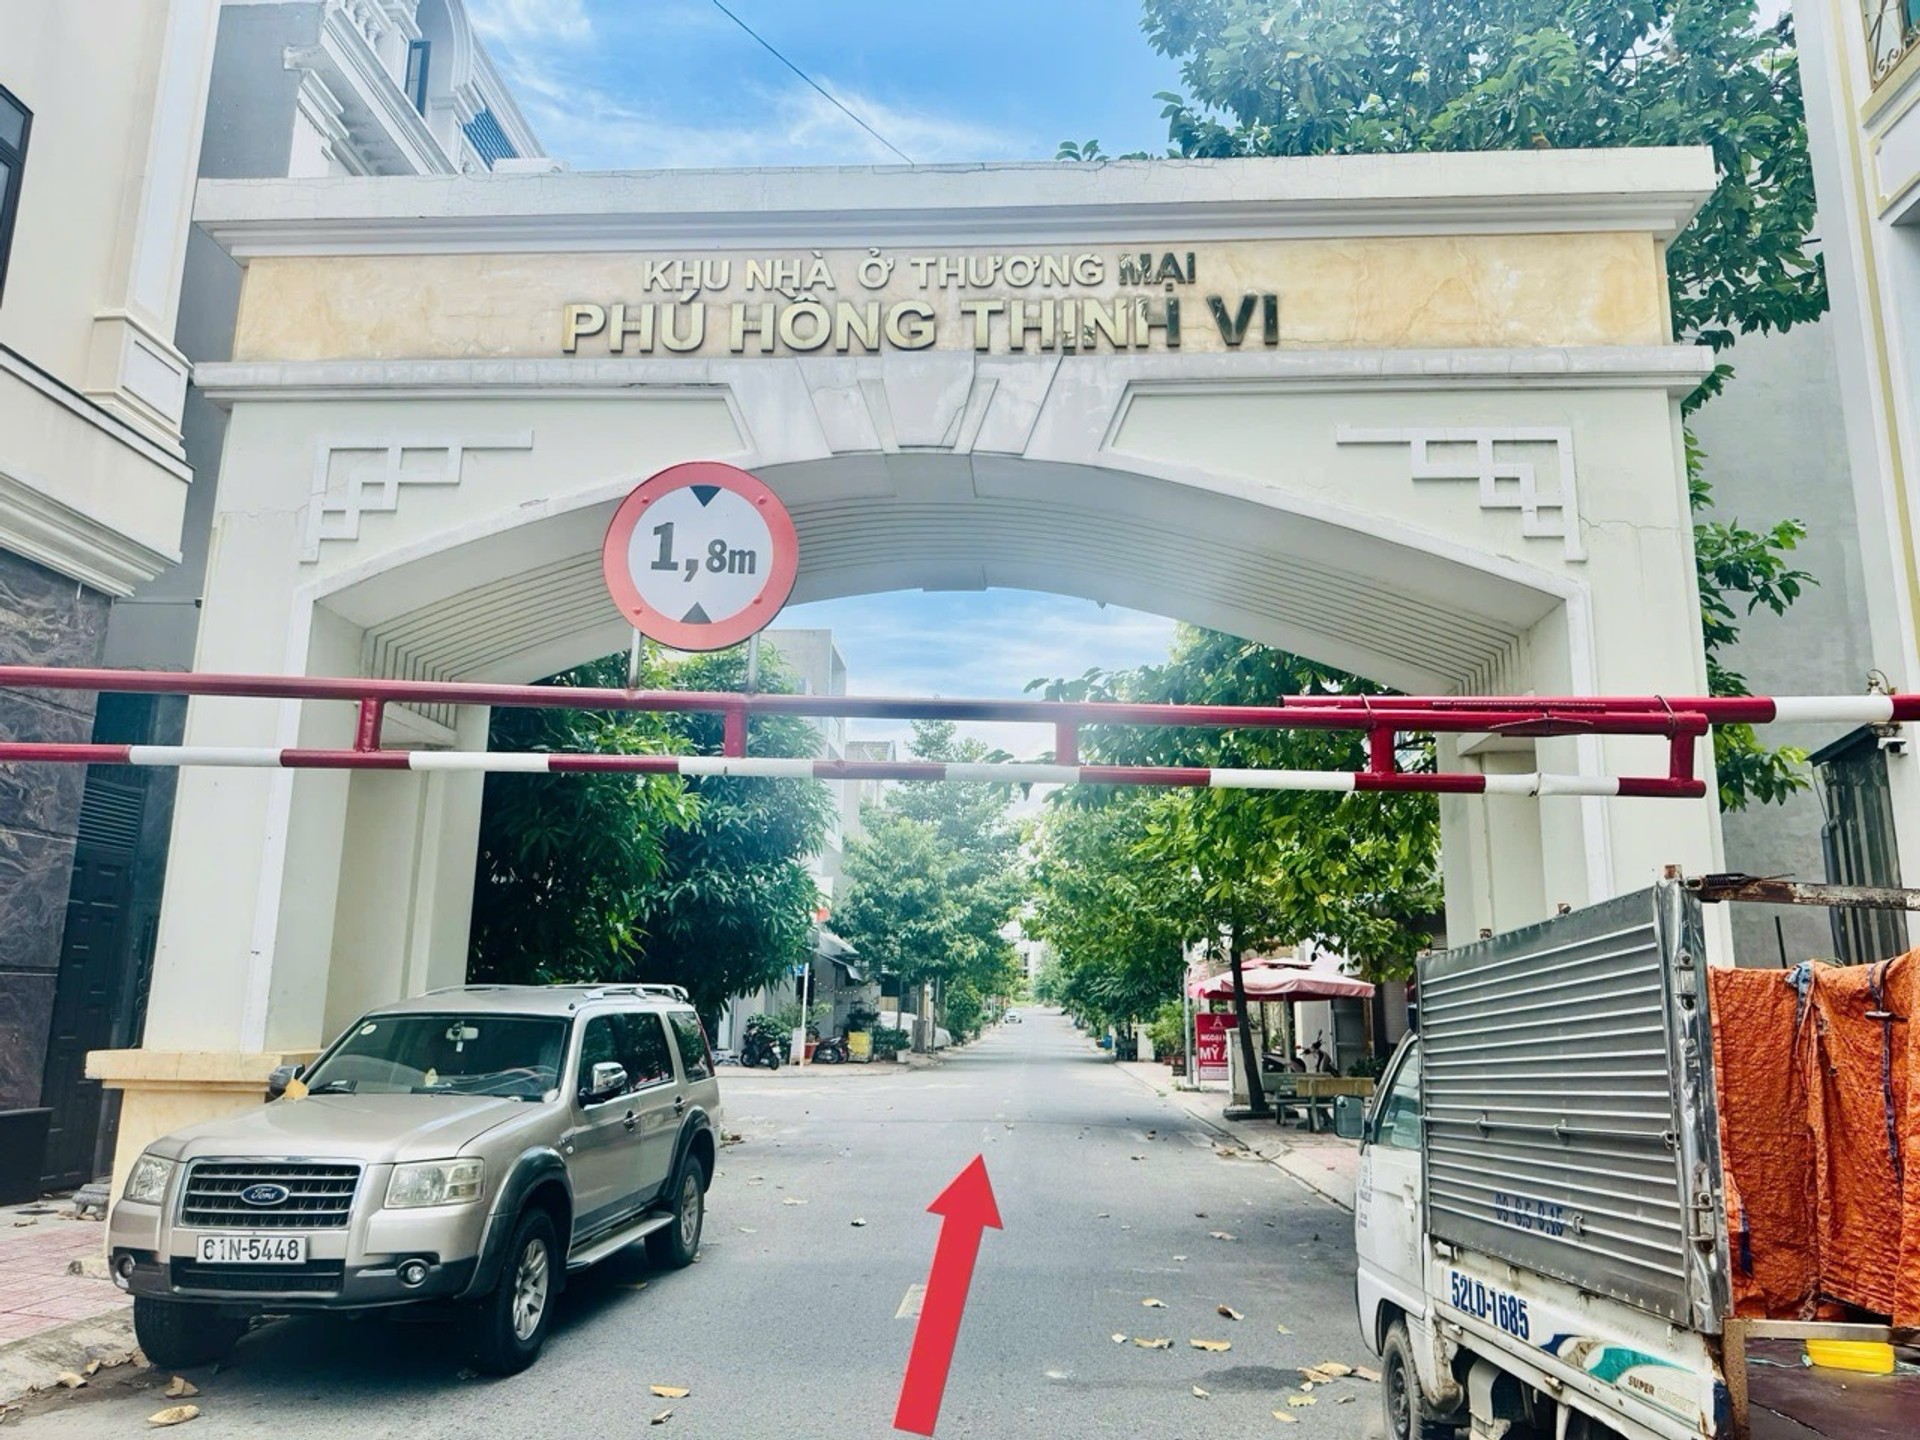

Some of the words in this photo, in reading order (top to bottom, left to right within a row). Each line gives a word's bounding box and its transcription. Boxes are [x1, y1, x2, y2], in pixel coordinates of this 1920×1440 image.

[643, 259, 730, 291] KHU
[746, 251, 836, 291] NHÀ
[858, 247, 895, 289] Ở
[911, 253, 1104, 289] THƯƠNG
[1118, 252, 1196, 292] MẠI
[563, 289, 704, 353] PHÚ
[730, 288, 936, 353] HỒNG
[961, 295, 1180, 356] THỊNH
[1206, 294, 1279, 347] VI
[651, 522, 757, 582] 1,8m
[1200, 1044, 1220, 1060] MỸ
[251, 1187, 277, 1200] Ford
[203, 1239, 299, 1261] 61N-5448
[1452, 1271, 1530, 1341] 52LD-1685
[1628, 1375, 1655, 1396] SUPER
